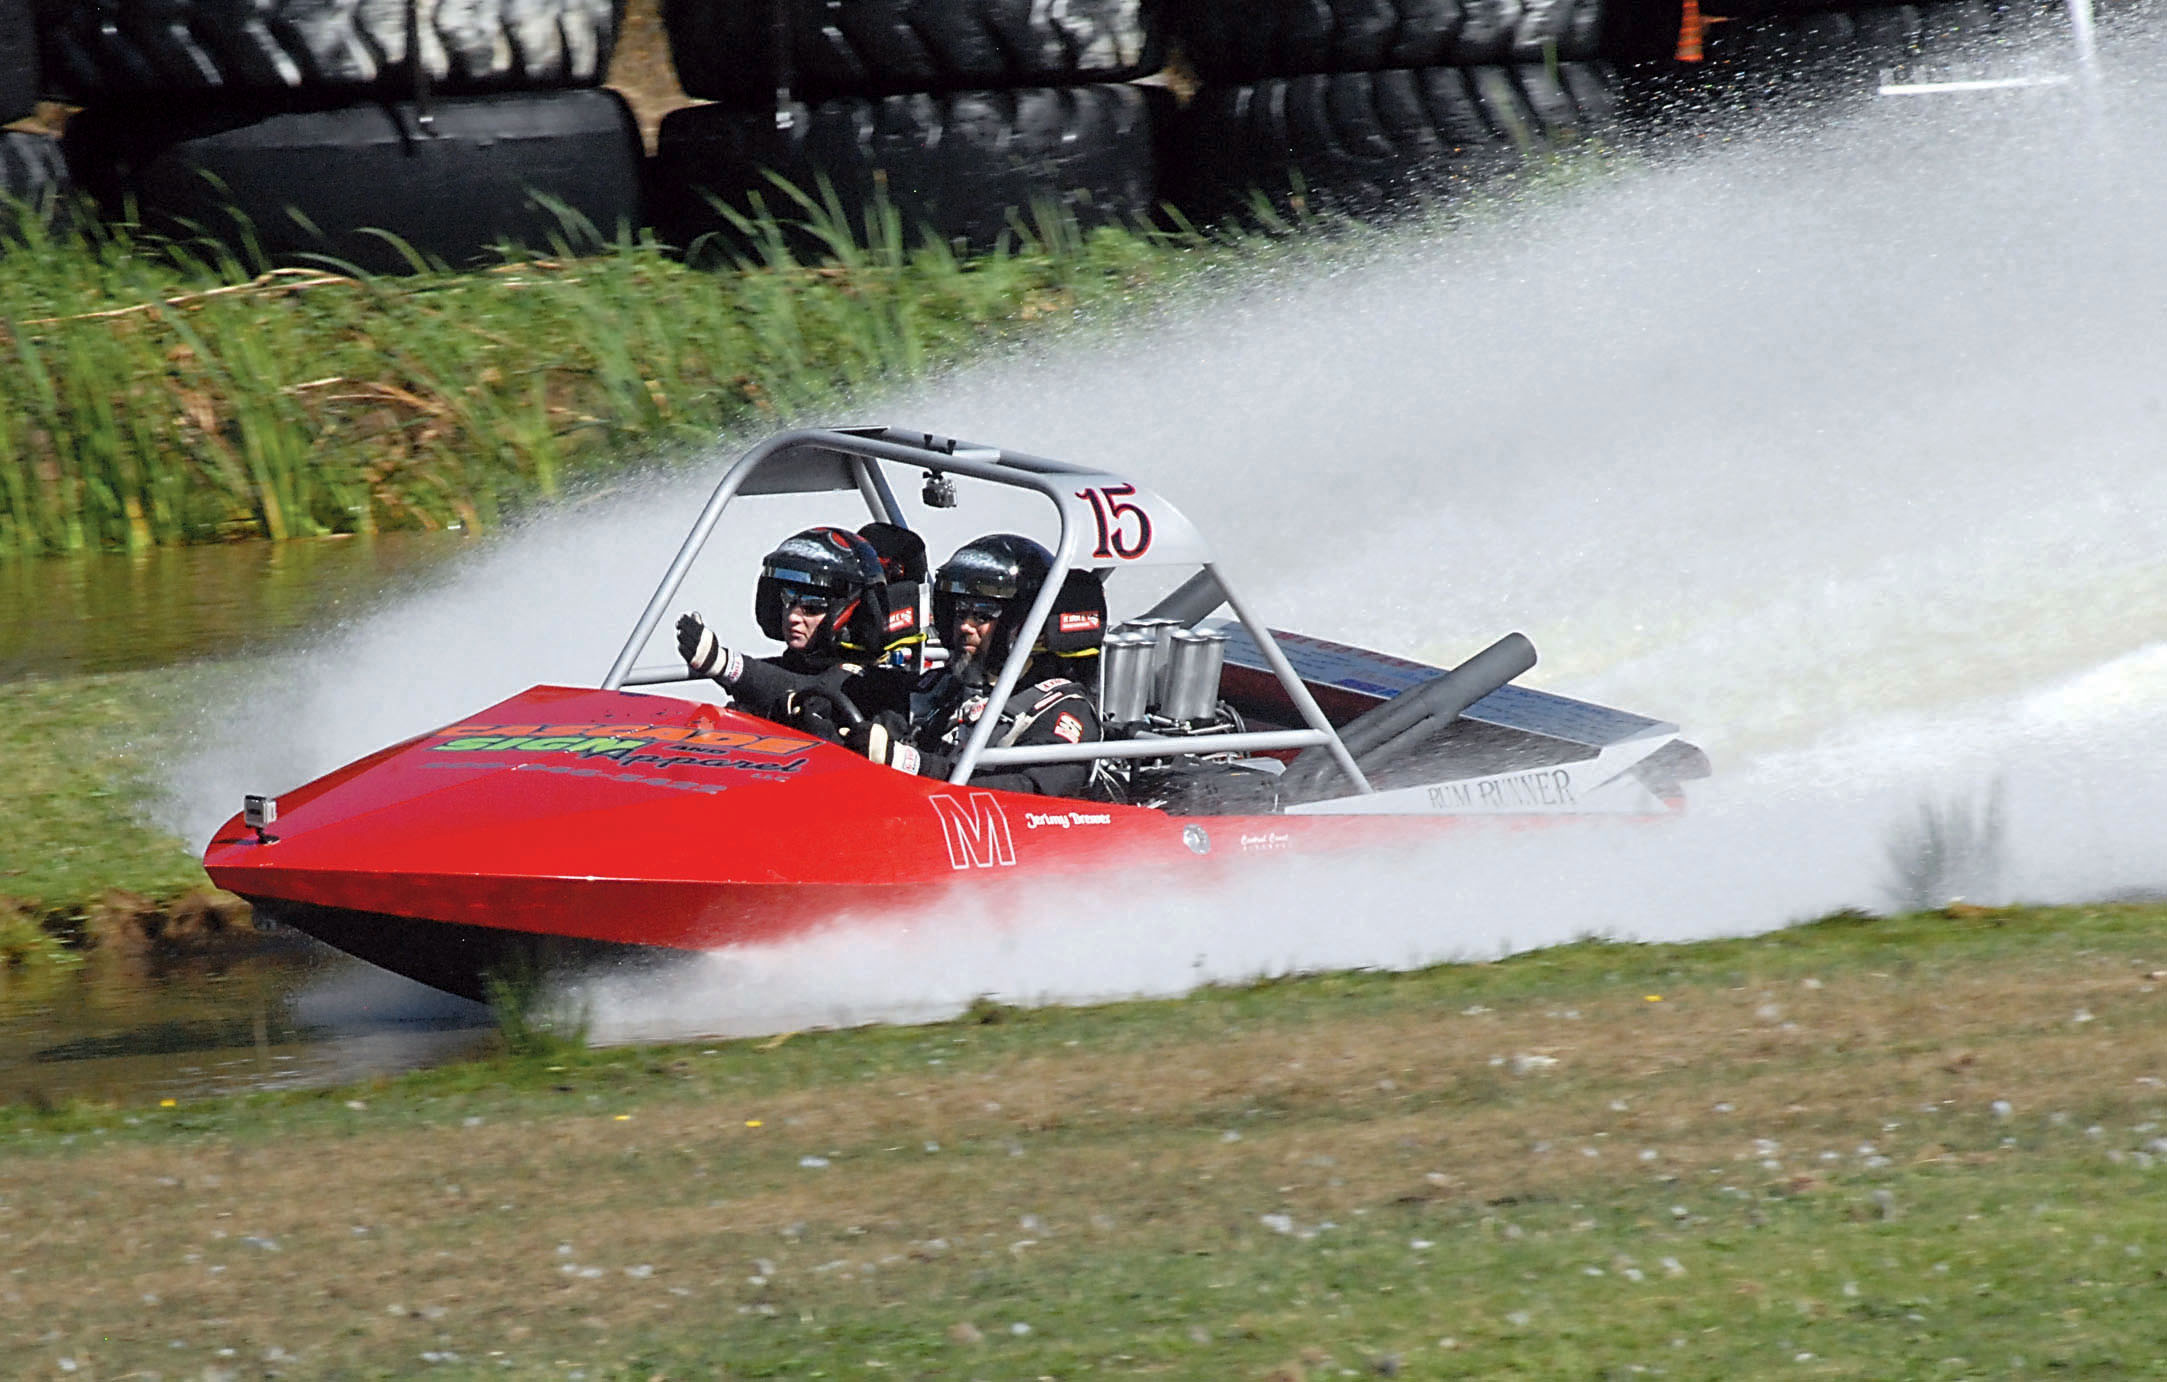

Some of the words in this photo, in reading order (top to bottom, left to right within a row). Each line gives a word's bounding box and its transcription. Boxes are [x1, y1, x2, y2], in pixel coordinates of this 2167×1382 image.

[1075, 482, 1152, 560] 15
[430, 736, 651, 752] SIGN
[432, 724, 824, 756] CASCADE
[665, 745, 730, 755] AND
[580, 743, 808, 773] Apparel
[1427, 783, 1473, 809] RUM
[1477, 768, 1577, 808] RUNNER
[928, 792, 1016, 870] M
